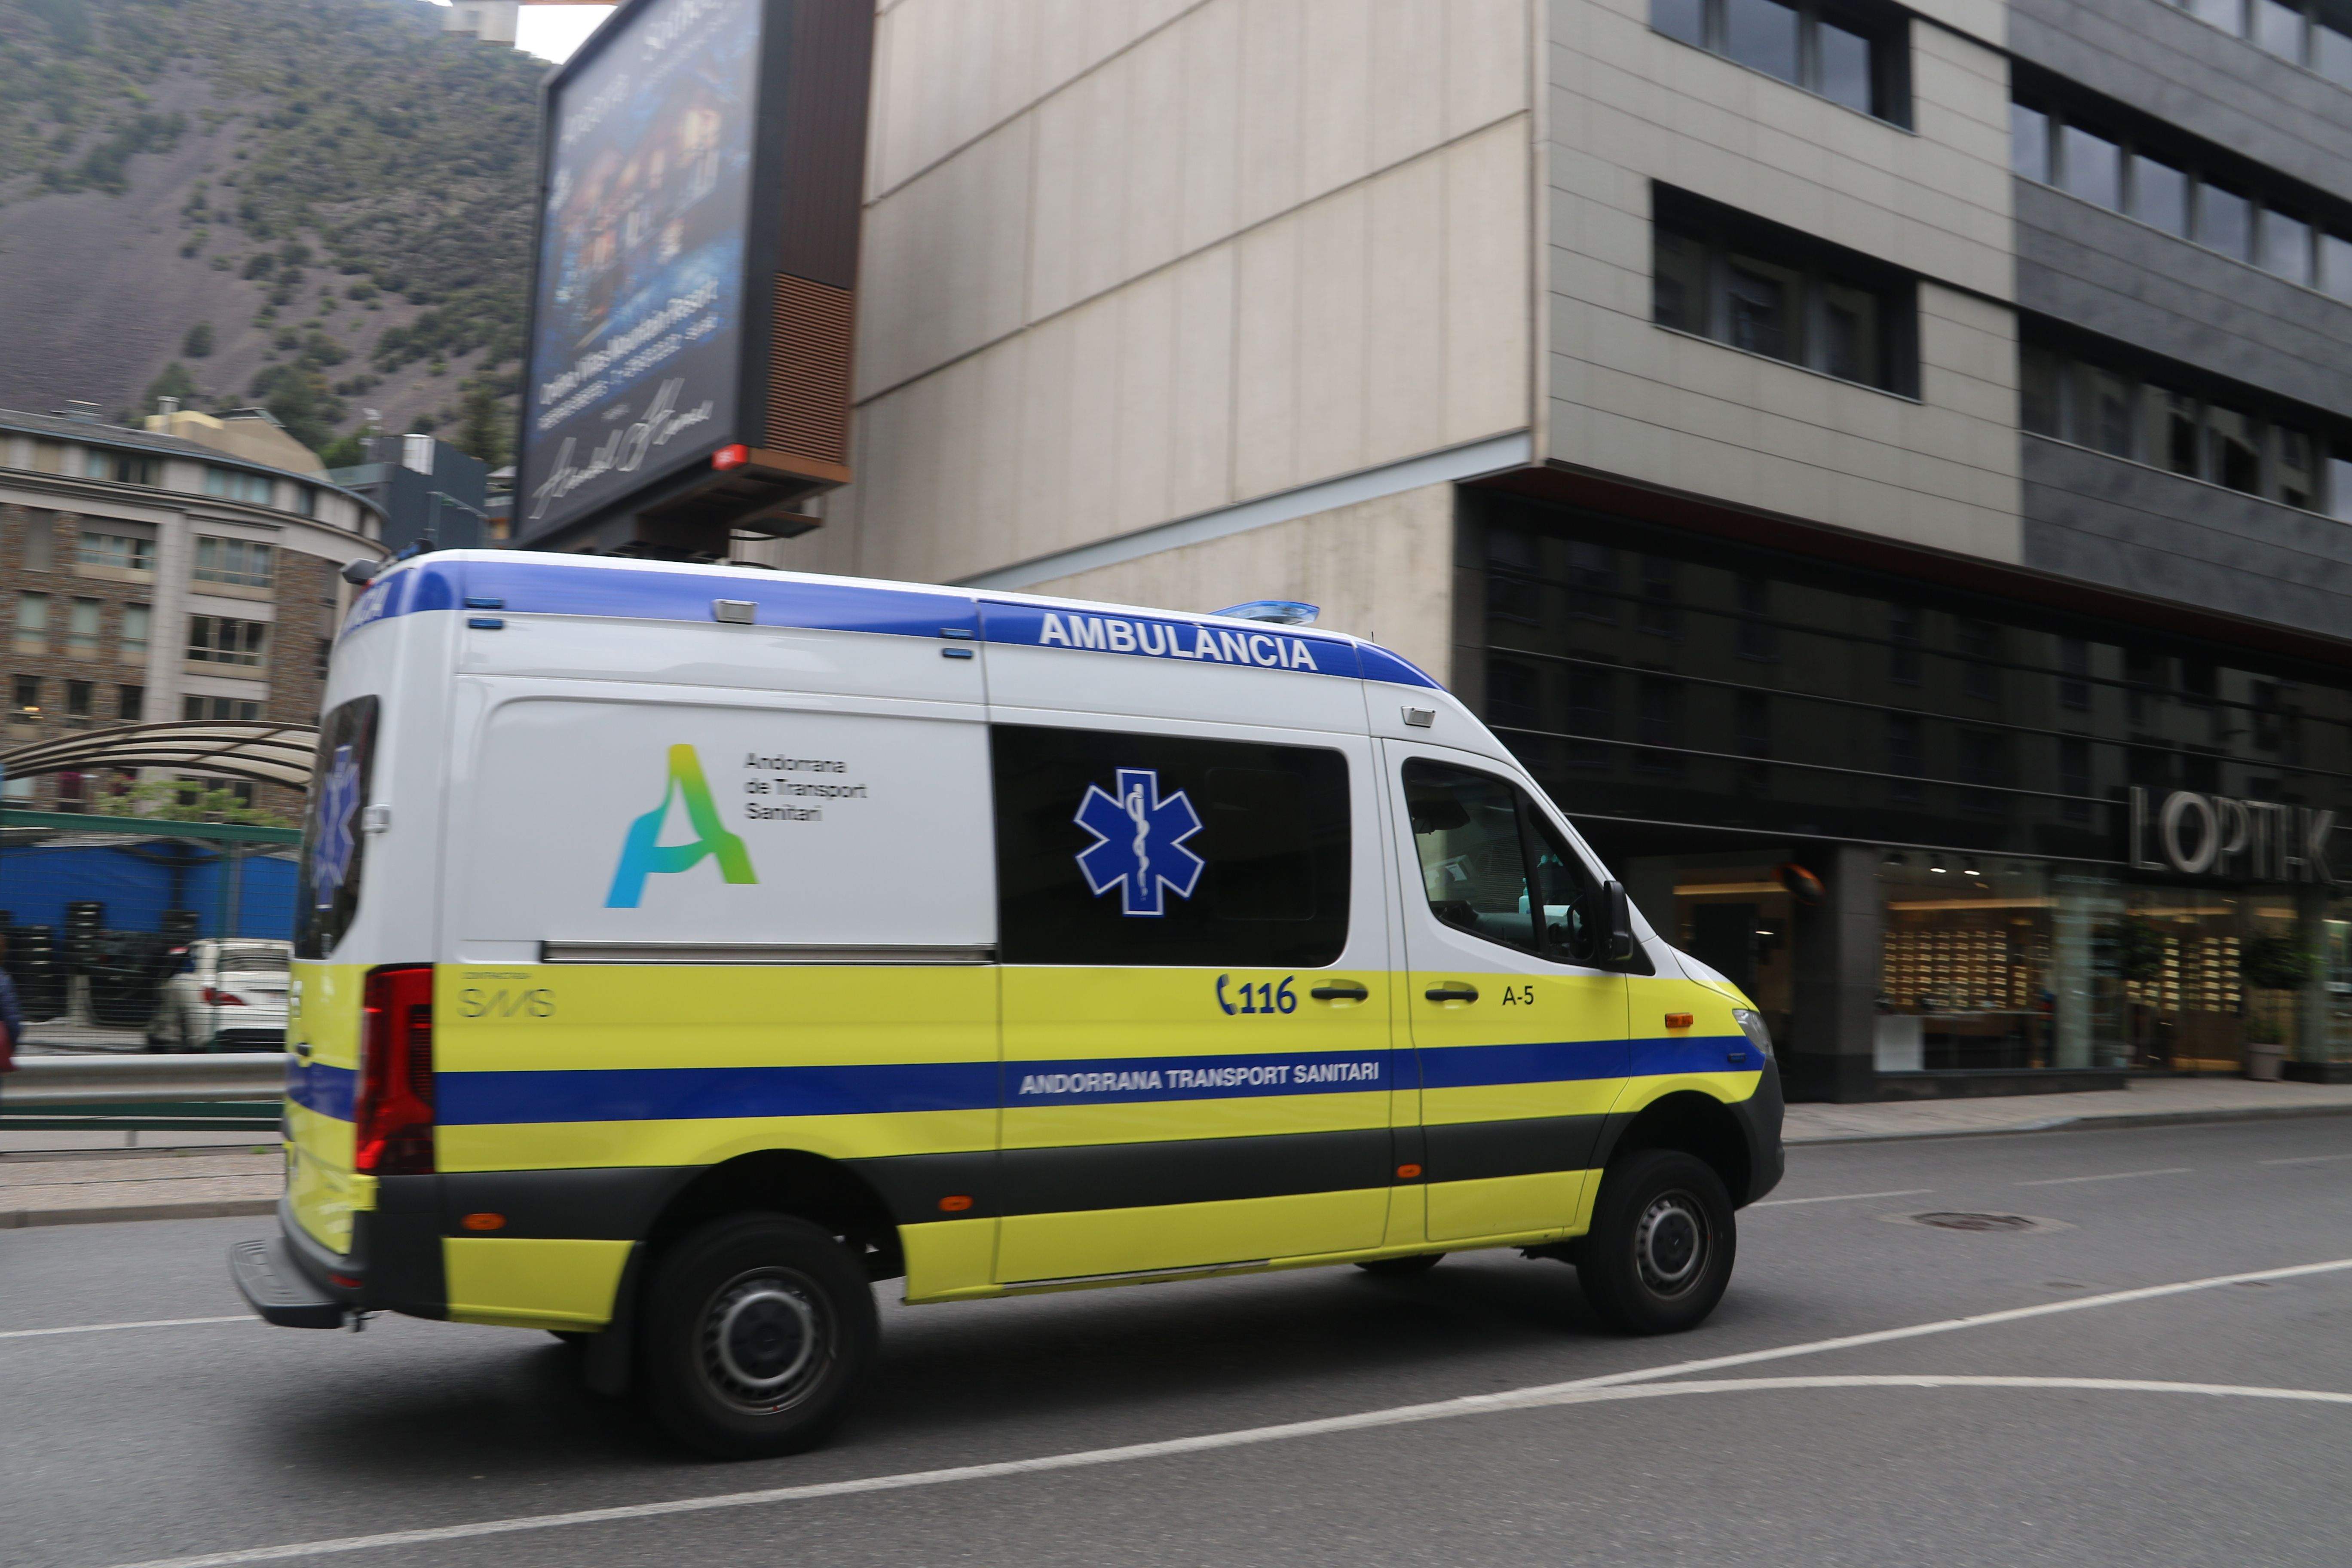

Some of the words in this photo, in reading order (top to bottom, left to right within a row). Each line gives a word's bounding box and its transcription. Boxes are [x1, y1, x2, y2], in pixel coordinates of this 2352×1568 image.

[1038, 612, 1319, 671] AMBULÀNCIA
[744, 752, 848, 774] Andorrana
[744, 777, 772, 795] de
[772, 778, 869, 800] Transport
[744, 802, 823, 821] Sanitari
[1238, 974, 1298, 1014] 116
[1501, 985, 1534, 1006] A-5
[1018, 1070, 1164, 1095] ANDORRANA
[1165, 1066, 1290, 1089] TRANSPORT
[1293, 1062, 1379, 1084] SANITARI
